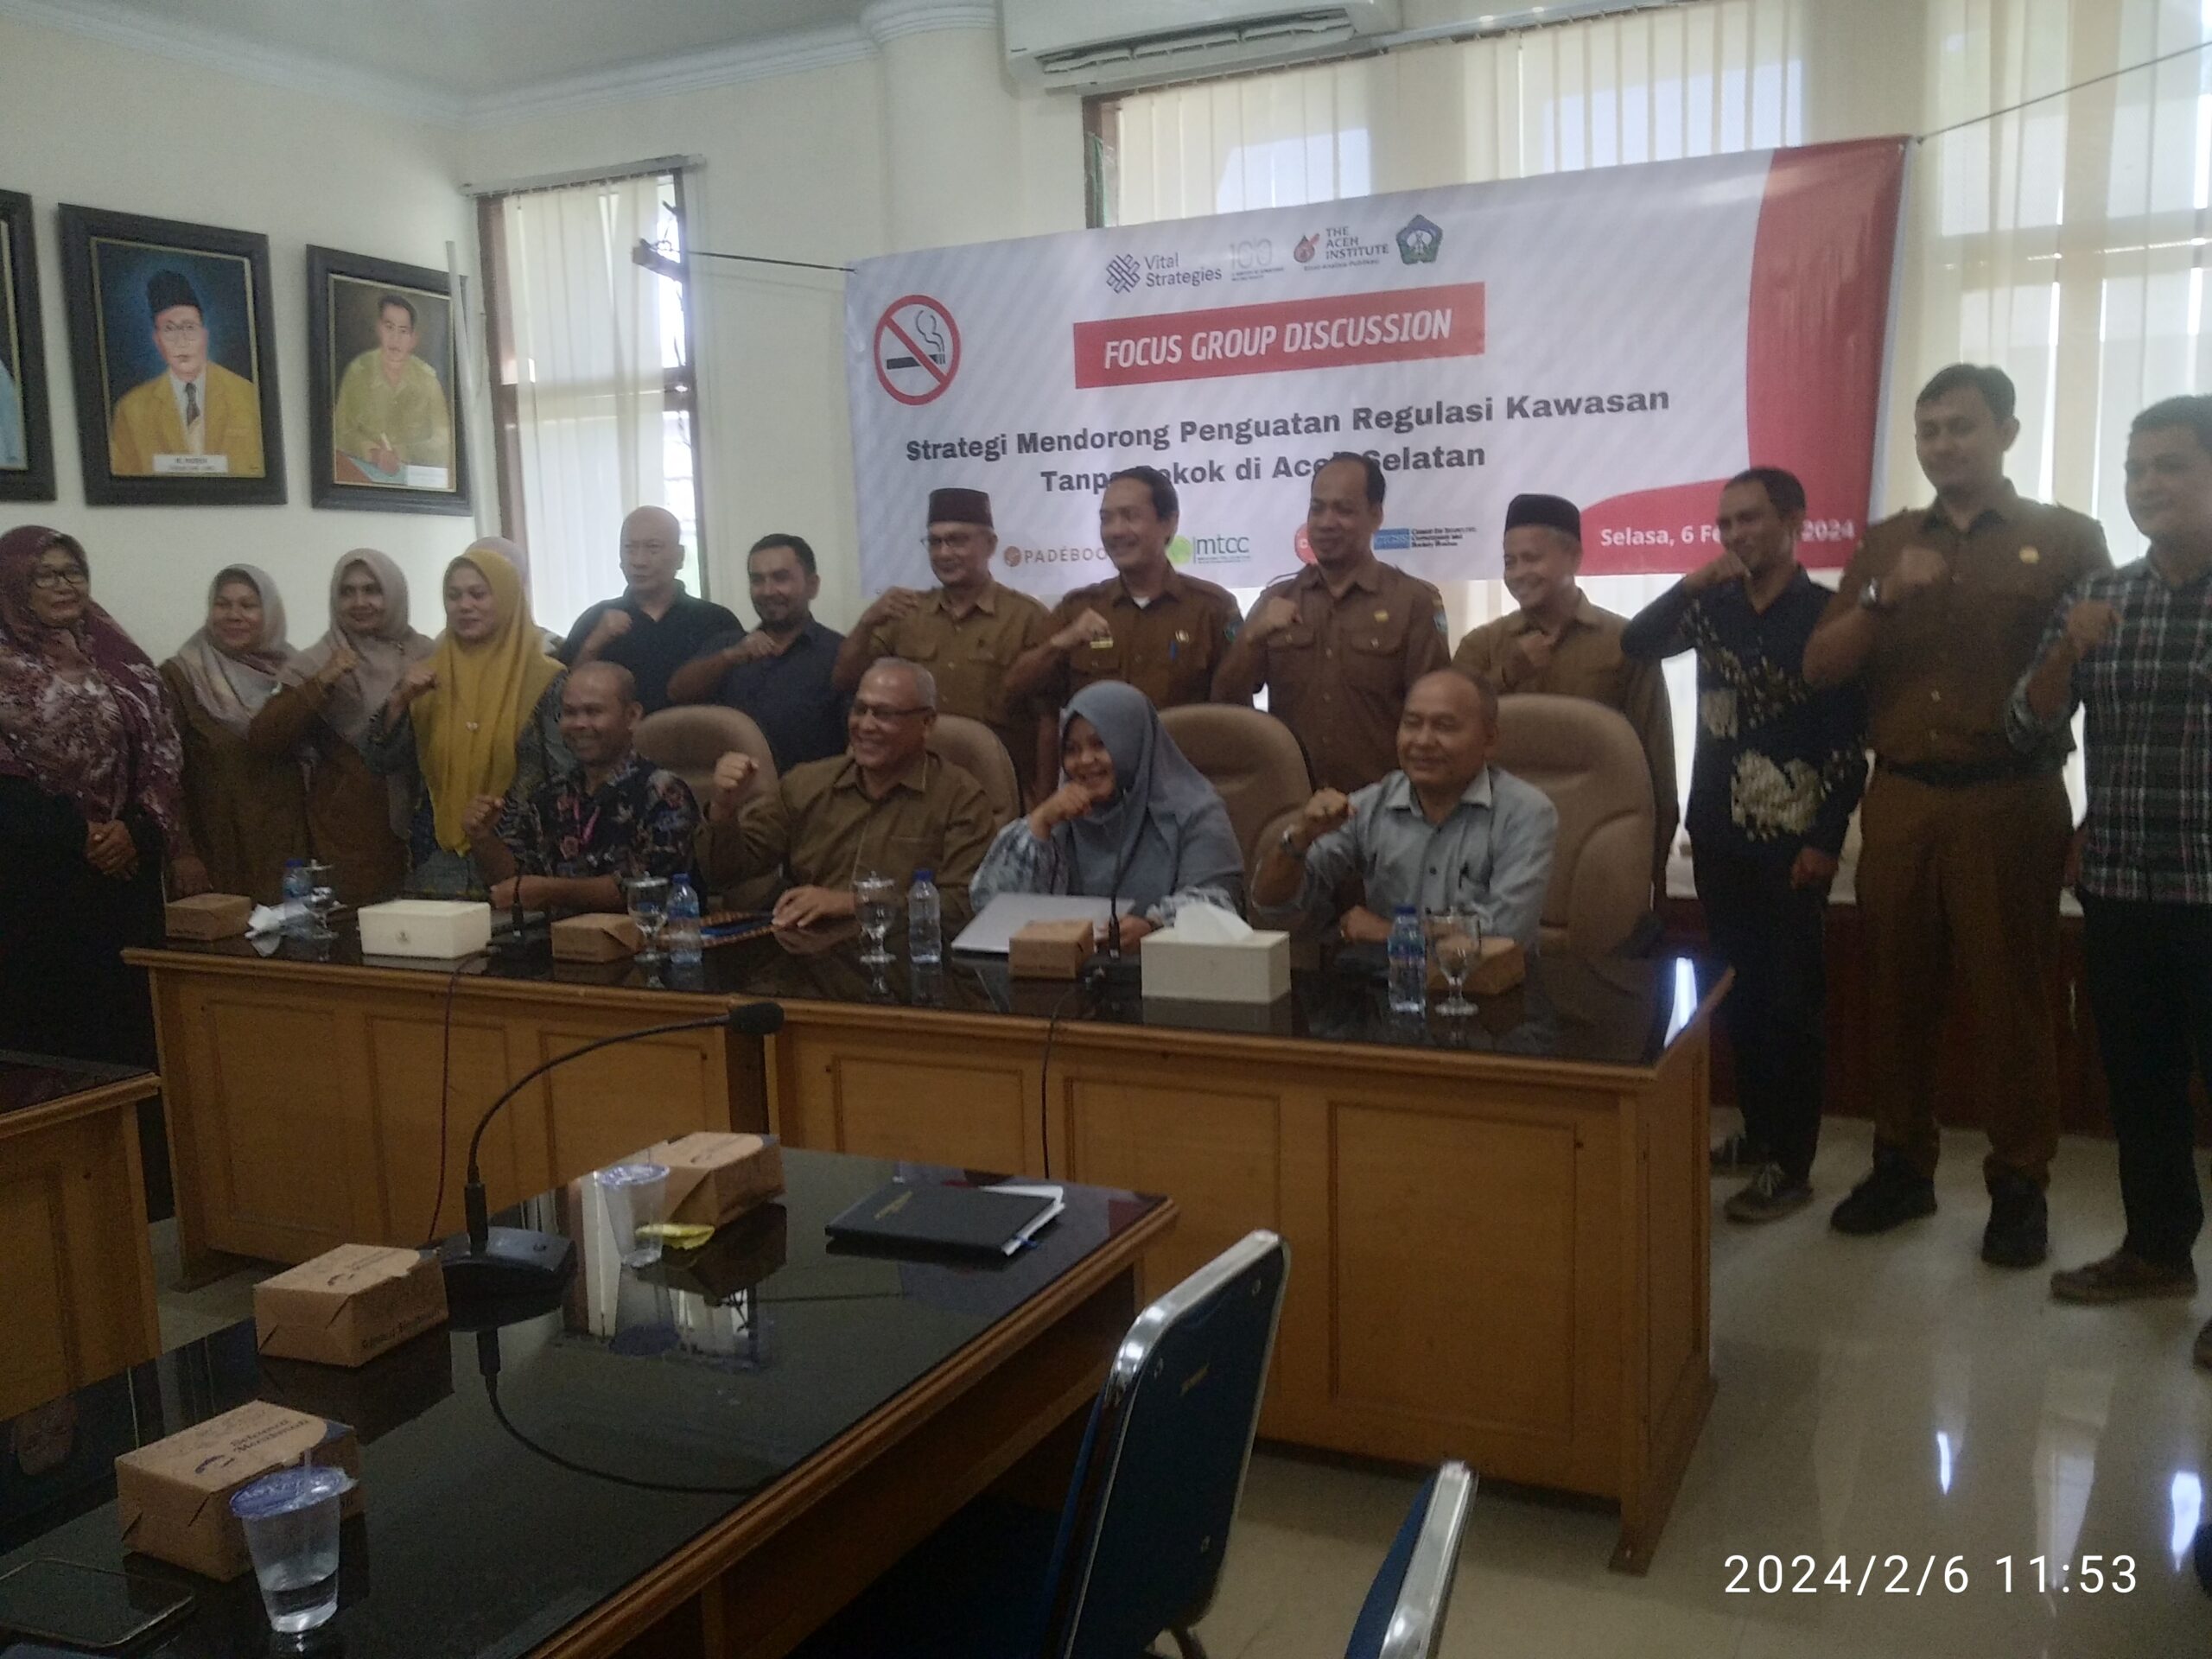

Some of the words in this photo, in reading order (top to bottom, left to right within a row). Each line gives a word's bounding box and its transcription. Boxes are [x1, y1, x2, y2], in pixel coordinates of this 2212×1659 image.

[1325, 226, 1349, 238] THE
[1144, 252, 1179, 270] Vital
[1325, 244, 1389, 260] INSTITUTE
[1146, 267, 1223, 287] Strategies
[1104, 334, 1183, 369] FOCUS
[1191, 325, 1276, 361] GROUP
[1283, 308, 1452, 353] DISCUSSION
[906, 434, 1007, 462] Strategi
[1017, 424, 1171, 455] Mendorong
[1180, 412, 1340, 445] Penguatan
[1352, 397, 1493, 434] Regulasi
[1506, 391, 1669, 419] Kawasan
[1160, 460, 1225, 485] kok
[1236, 457, 1262, 480] di
[1272, 452, 1341, 478] Ace
[1600, 526, 1675, 547] Selasa,
[1681, 525, 1694, 543] 6
[1801, 519, 1855, 543] 2024
[1196, 534, 1249, 555] mtcc
